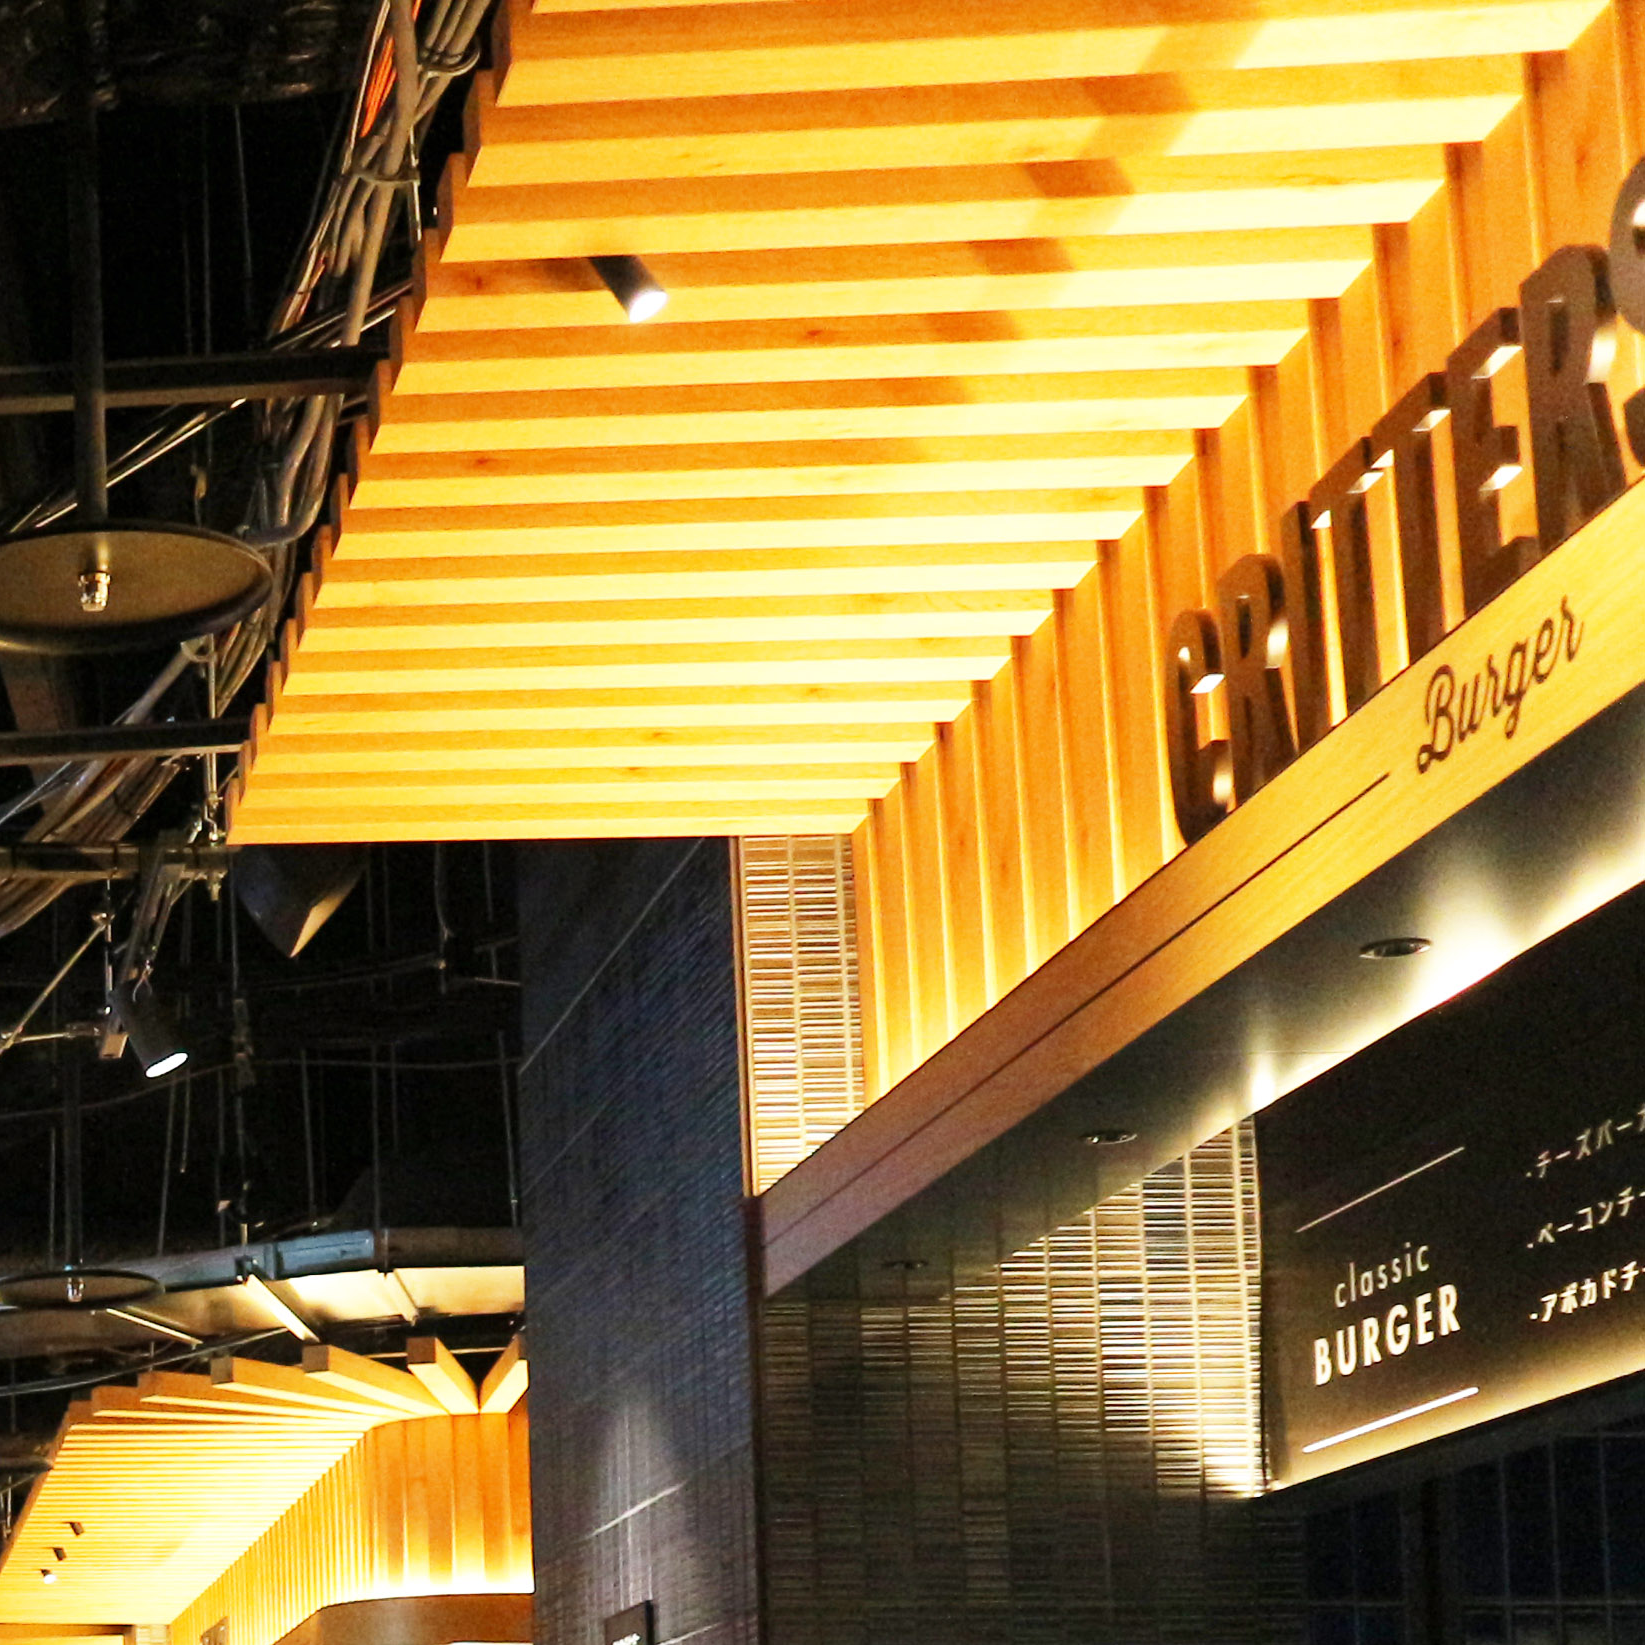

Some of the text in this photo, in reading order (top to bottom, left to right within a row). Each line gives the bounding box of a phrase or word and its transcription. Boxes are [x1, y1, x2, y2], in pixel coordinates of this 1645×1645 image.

[1417, 594, 1584, 774] Burger
[1335, 1242, 1430, 1308] classic
[1314, 1285, 1461, 1386] BURGER
